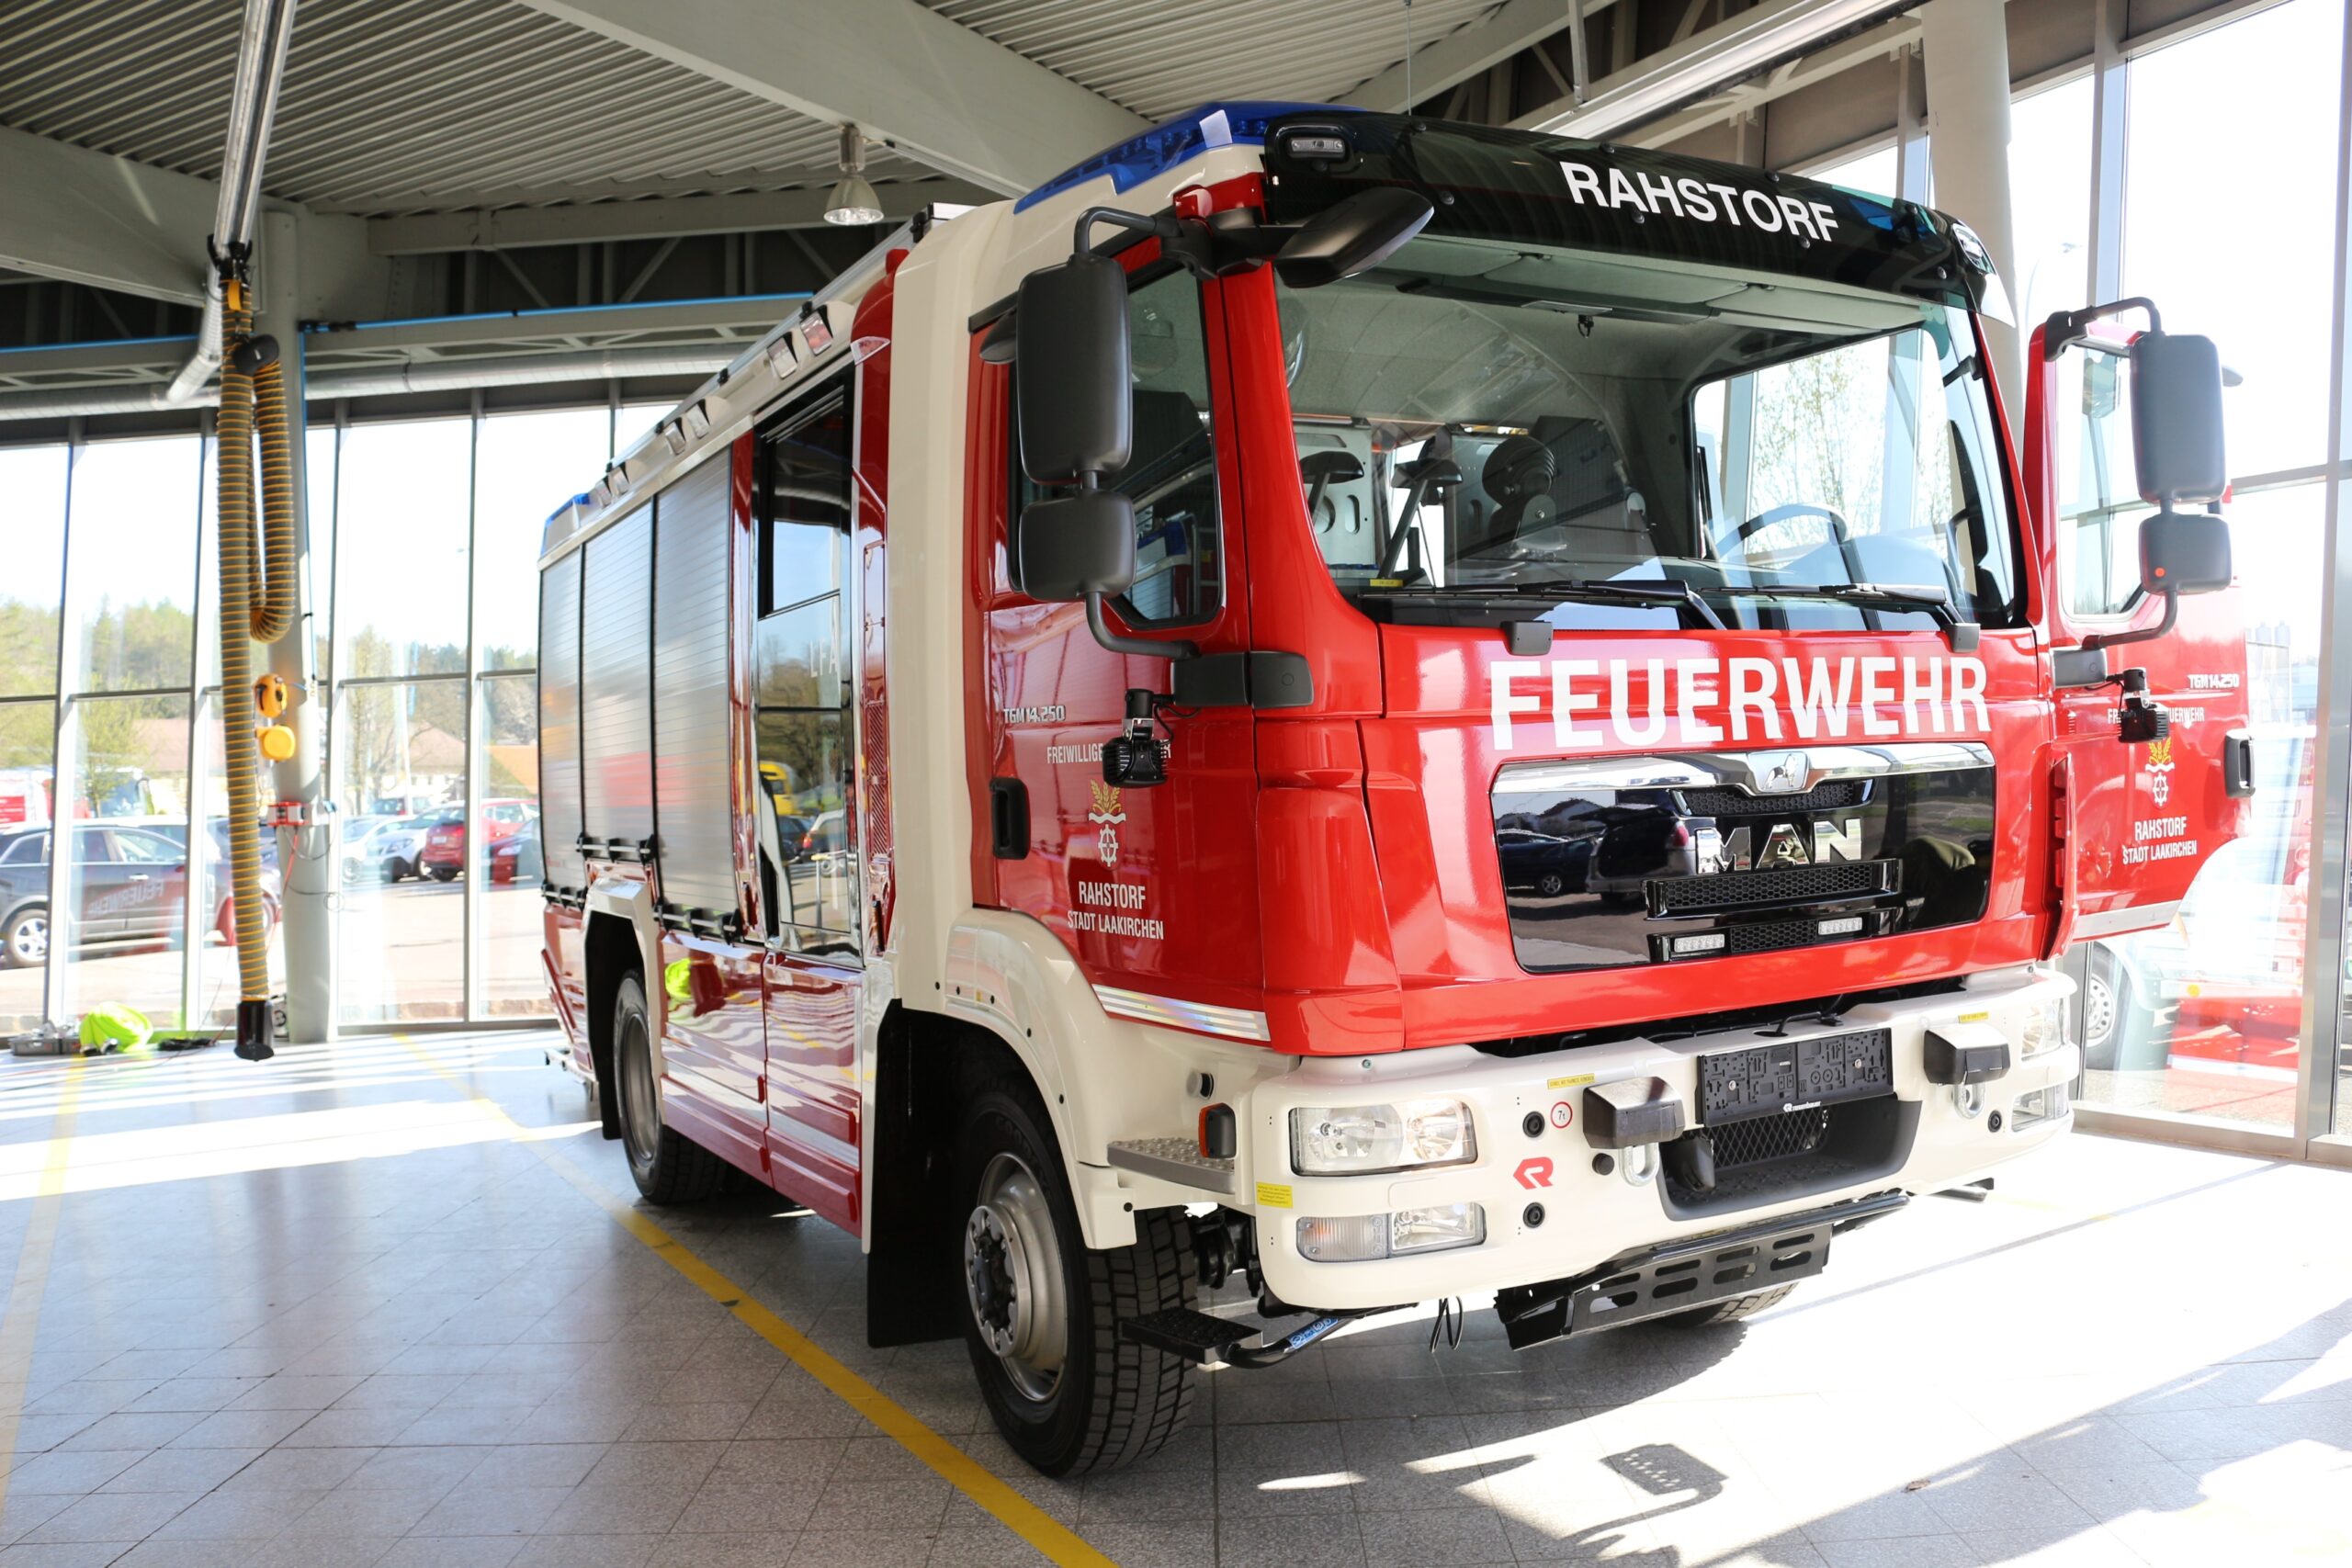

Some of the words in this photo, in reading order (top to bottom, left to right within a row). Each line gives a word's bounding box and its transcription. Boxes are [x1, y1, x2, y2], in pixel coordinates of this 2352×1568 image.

[1559, 161, 1838, 242] RAHSTORF
[2188, 673, 2207, 689] TGM
[1003, 706, 1025, 724] TGM
[1026, 705, 1066, 723] 14.250
[1490, 656, 1992, 750] FEUERWEHR
[2168, 706, 2205, 724] UERWEHR
[1047, 742, 1103, 764] FREIWILLIGE
[2134, 816, 2188, 841] RAHSTORF
[1697, 818, 1862, 874] MAN
[2122, 845, 2149, 865] STADT
[2150, 840, 2198, 861] LAAKIRCHEN
[1079, 881, 1146, 909] RAHSTORF
[1067, 909, 1096, 931] STADT
[1098, 913, 1164, 940] LAAKIRCHEN
